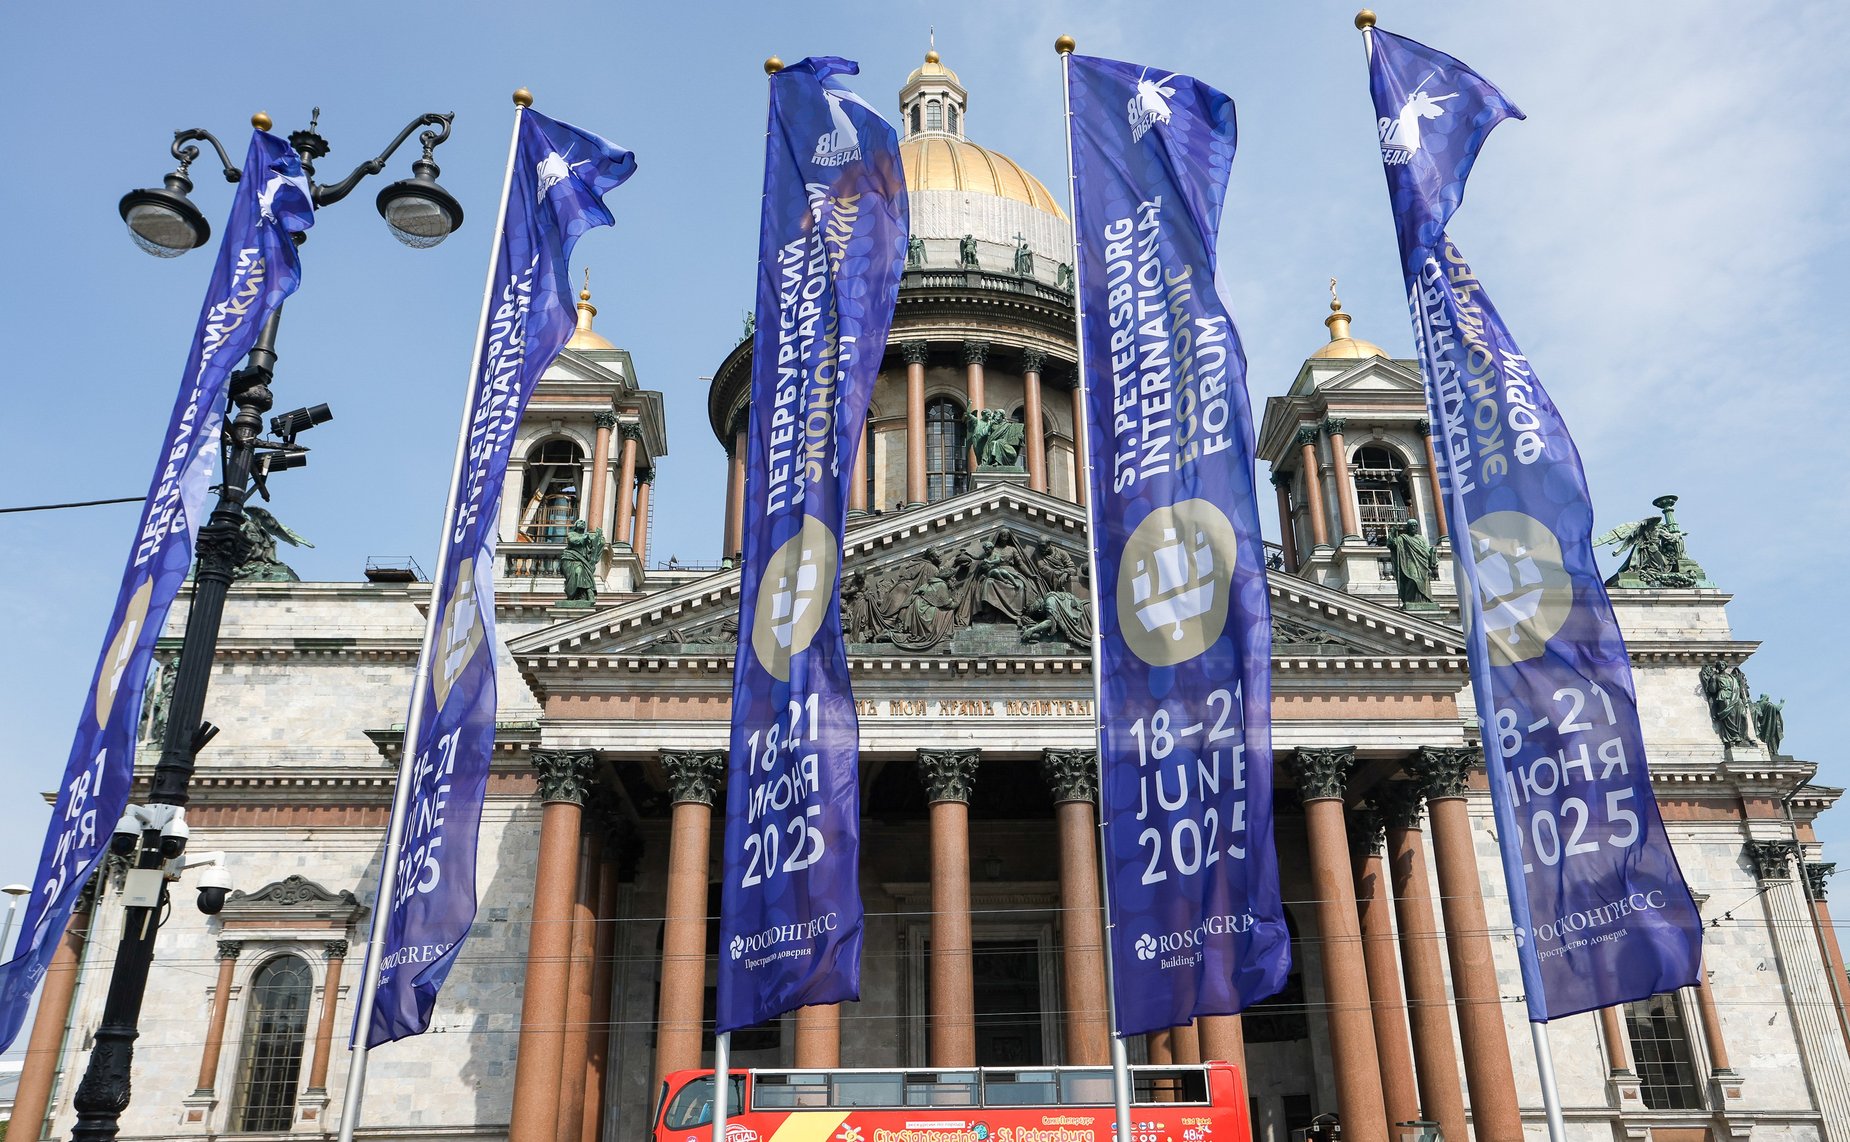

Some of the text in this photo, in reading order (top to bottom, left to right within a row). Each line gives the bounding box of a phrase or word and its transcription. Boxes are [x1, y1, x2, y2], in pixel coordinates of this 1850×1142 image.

[811, 150, 862, 167] ПОБЕДА!
[1382, 149, 1412, 166] ЕДА!
[804, 193, 861, 484] ЭКОНОМКИЙ
[1105, 217, 1138, 494] ST. PETERSBURG
[1137, 195, 1172, 480] INTERNATIONAL
[1165, 264, 1199, 471] ECONOMIC
[1422, 256, 1476, 496] МЕЖДУНАРО
[1445, 236, 1508, 485] ЭКОНОМИЧЕС
[1195, 315, 1232, 456] FORUM
[1499, 348, 1545, 466] ФОРУМ
[1493, 680, 1617, 759] 8–21
[748, 754, 819, 825] ИЮНЯ
[1136, 743, 1246, 821] JUNE
[741, 804, 826, 889] 2025
[1138, 800, 1246, 886] 2025
[777, 947, 812, 960] доверия
[1161, 955, 1195, 970] Building
[1590, 928, 1628, 946] доверия
[725, 1131, 757, 1142] FICIAL
[998, 1126, 1094, 1142] St Petersburg
